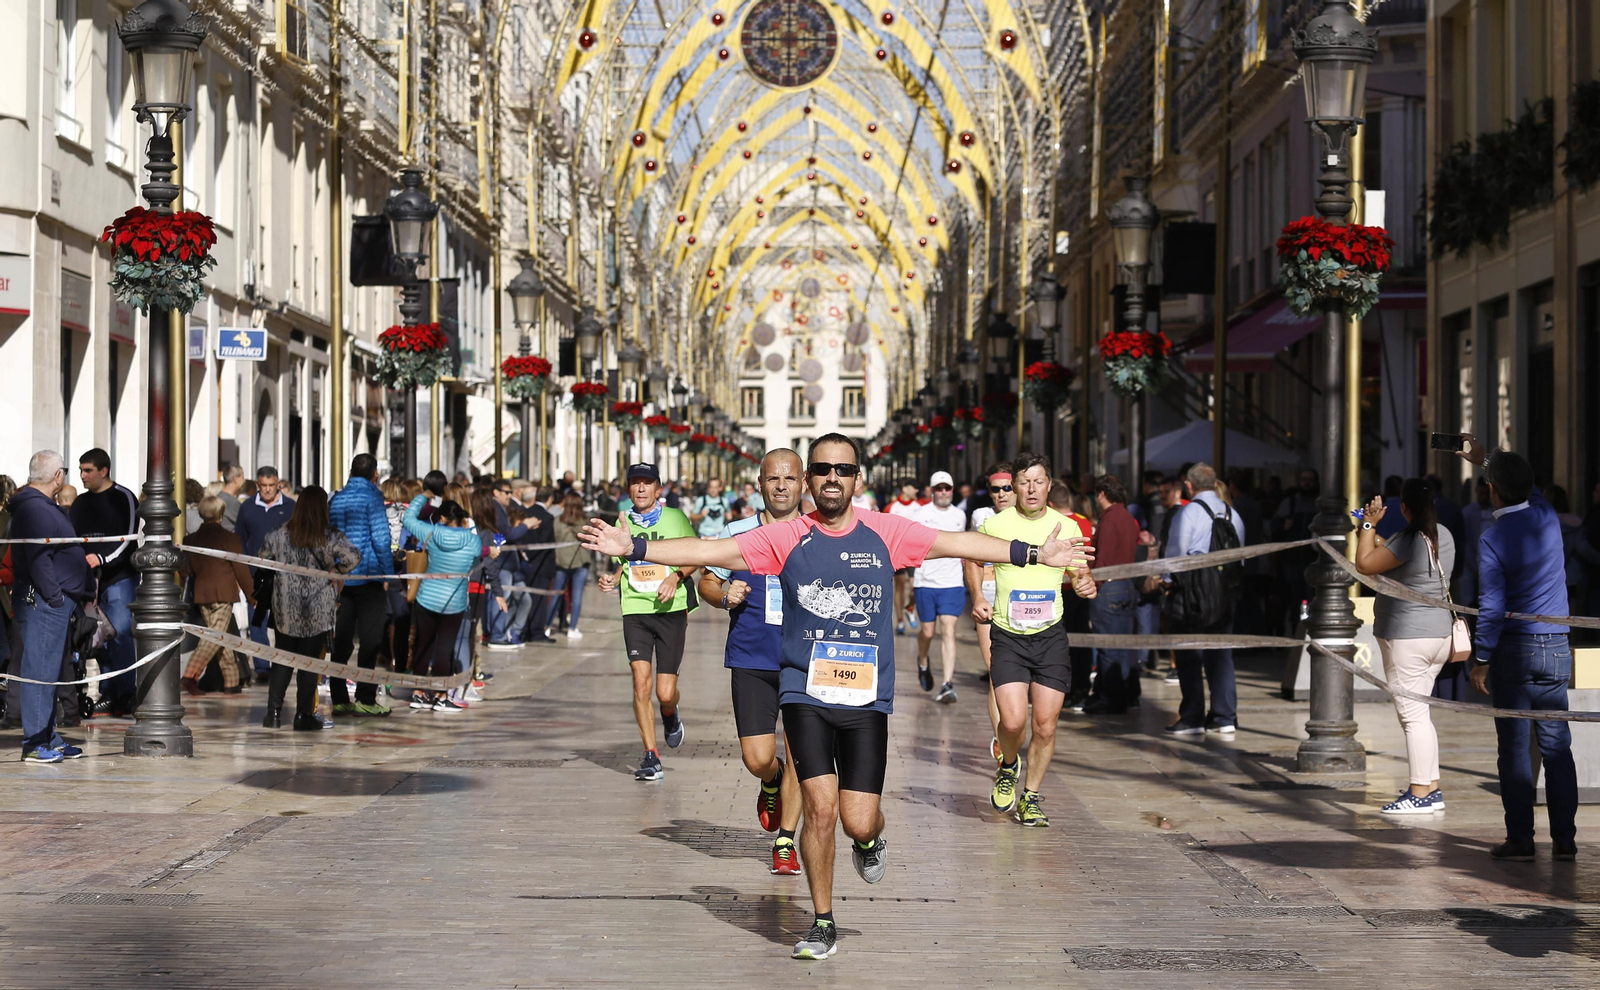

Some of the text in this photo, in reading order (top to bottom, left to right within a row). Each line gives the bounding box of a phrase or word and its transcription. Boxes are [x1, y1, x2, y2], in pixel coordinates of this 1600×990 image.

[221, 346, 262, 357] TELEBANCO
[848, 583, 882, 598] 2018
[856, 599, 881, 613] 42K
[1024, 607, 1042, 615] 2859
[838, 649, 864, 658] ZURICH
[832, 669, 857, 680] 1490
